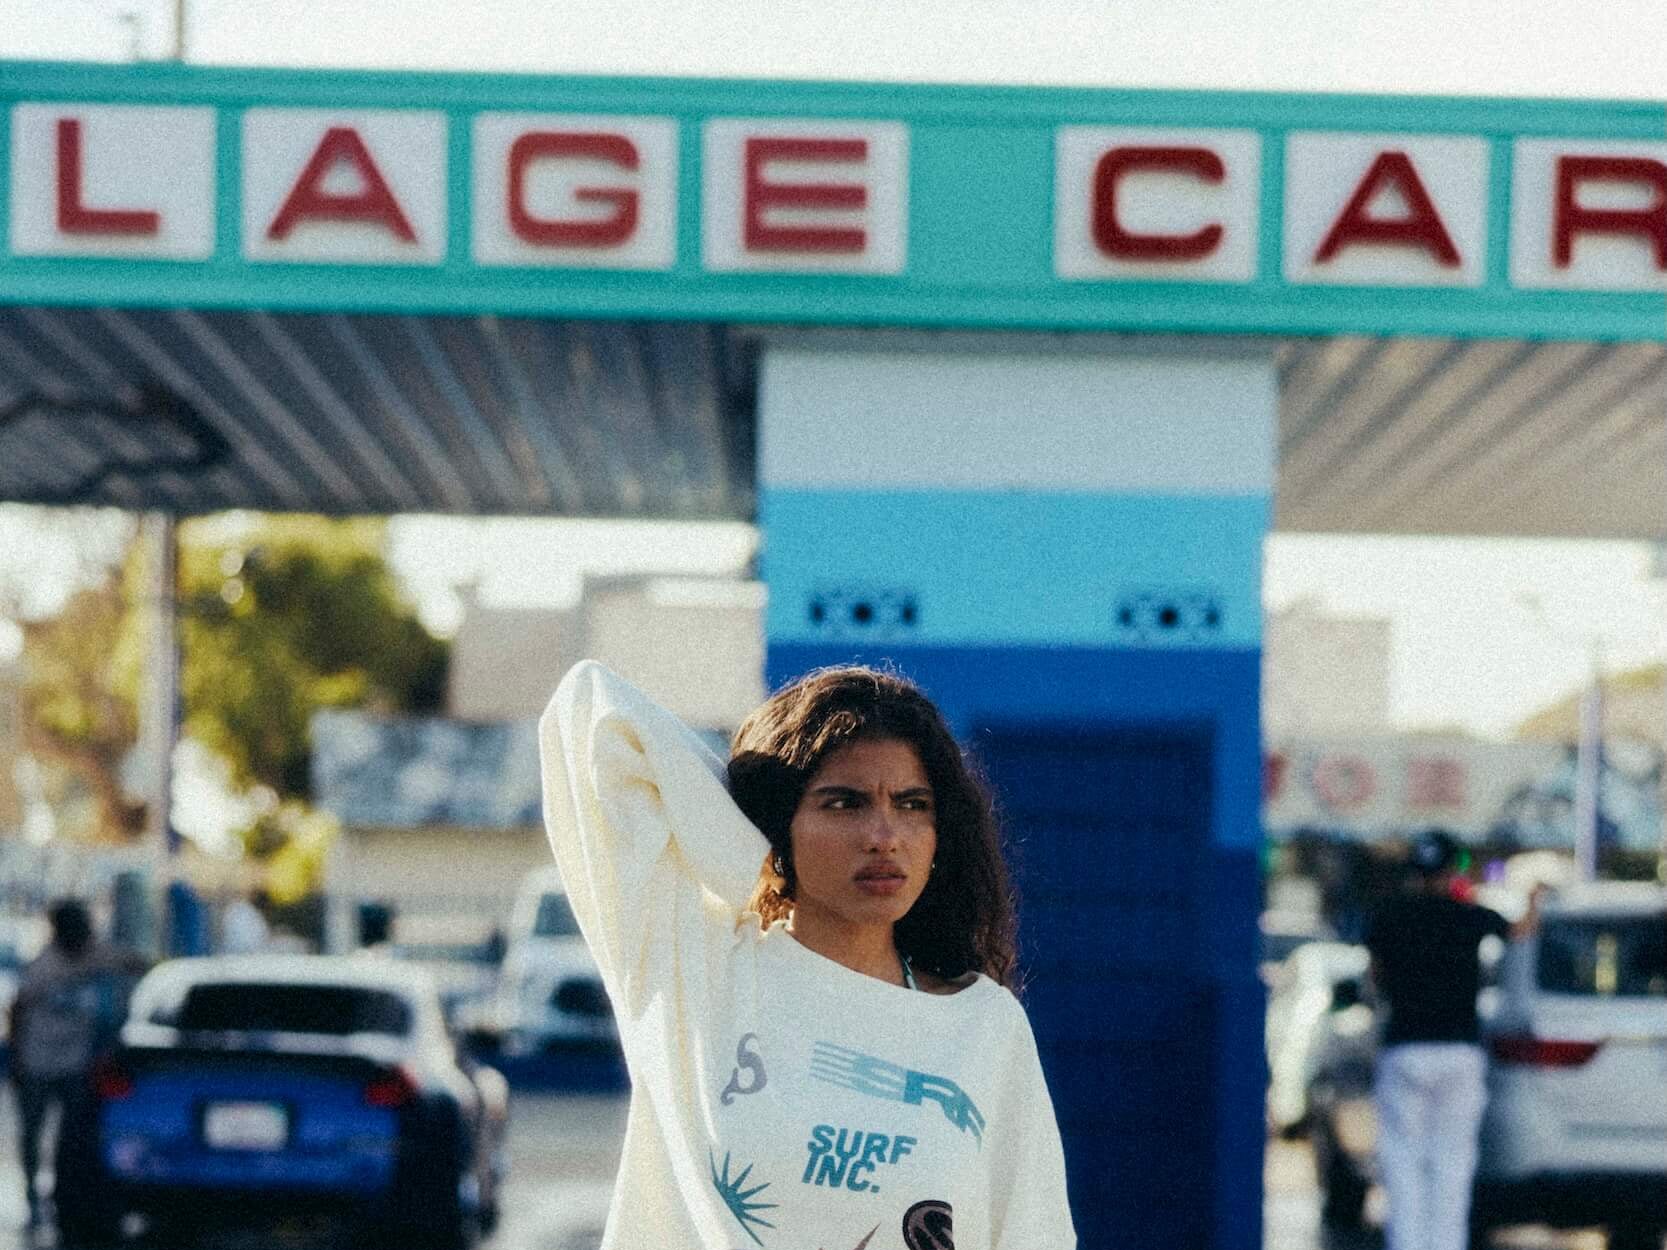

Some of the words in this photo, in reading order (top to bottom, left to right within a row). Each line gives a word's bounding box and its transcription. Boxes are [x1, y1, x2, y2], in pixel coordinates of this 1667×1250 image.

[56, 117, 869, 255] LAGE
[1090, 145, 1667, 272] CAR
[807, 1123, 918, 1165] SURF
[802, 1150, 881, 1193] INC.
